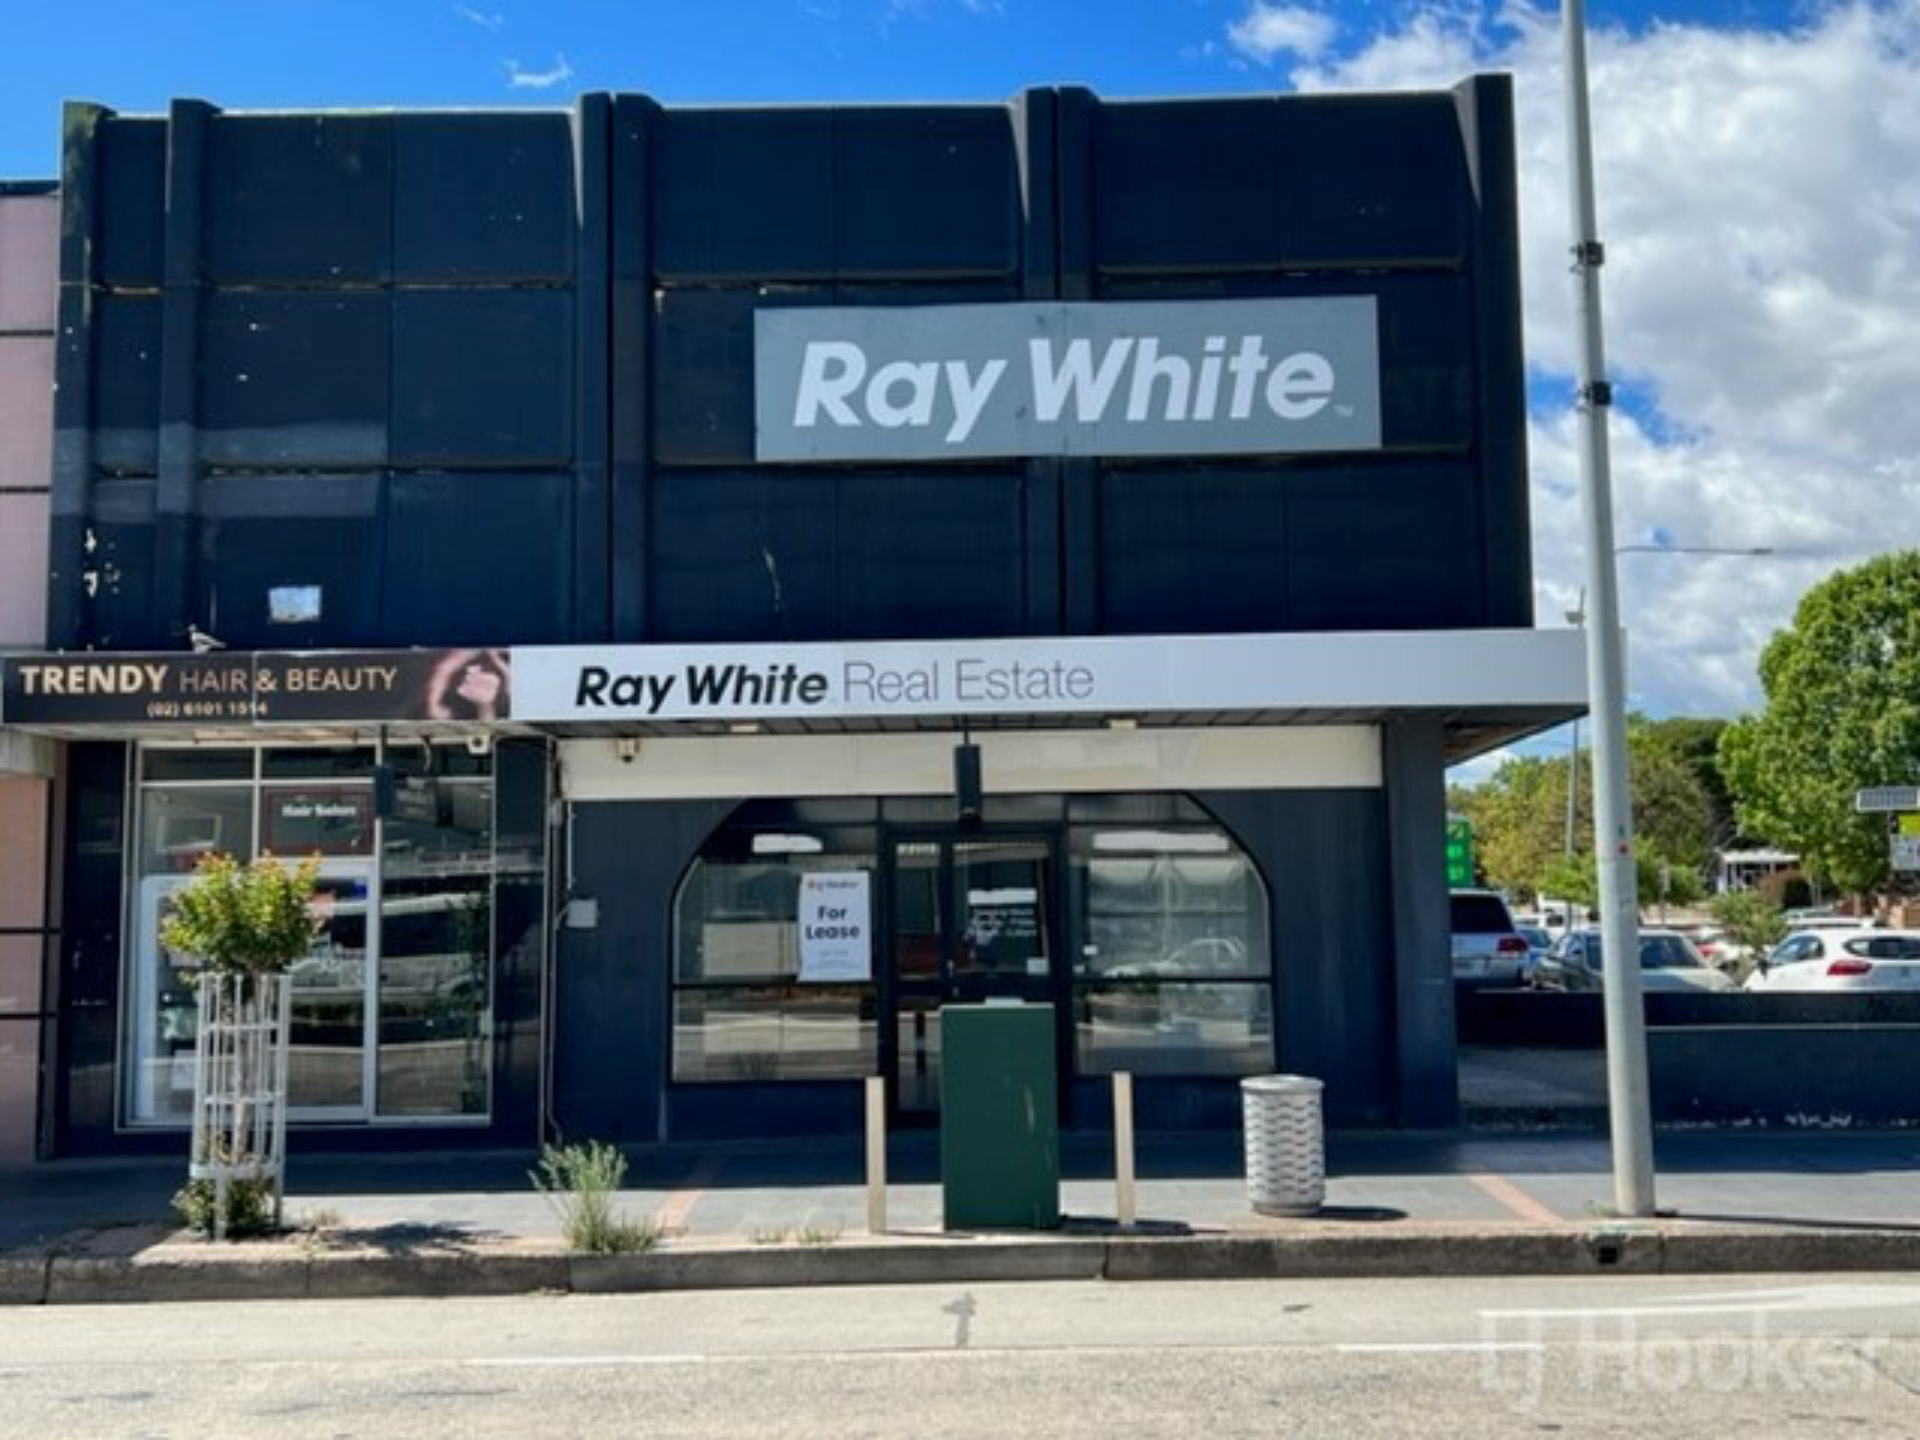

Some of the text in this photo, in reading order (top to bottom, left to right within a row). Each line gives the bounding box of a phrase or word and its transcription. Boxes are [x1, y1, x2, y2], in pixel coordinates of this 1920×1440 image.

[793, 335, 1335, 443] Ray White
[18, 664, 397, 695] TRENDY HAIR & BEAUTY
[575, 659, 1095, 714] Ray White Real Estate
[817, 905, 848, 920] For
[804, 924, 861, 940] Lease
